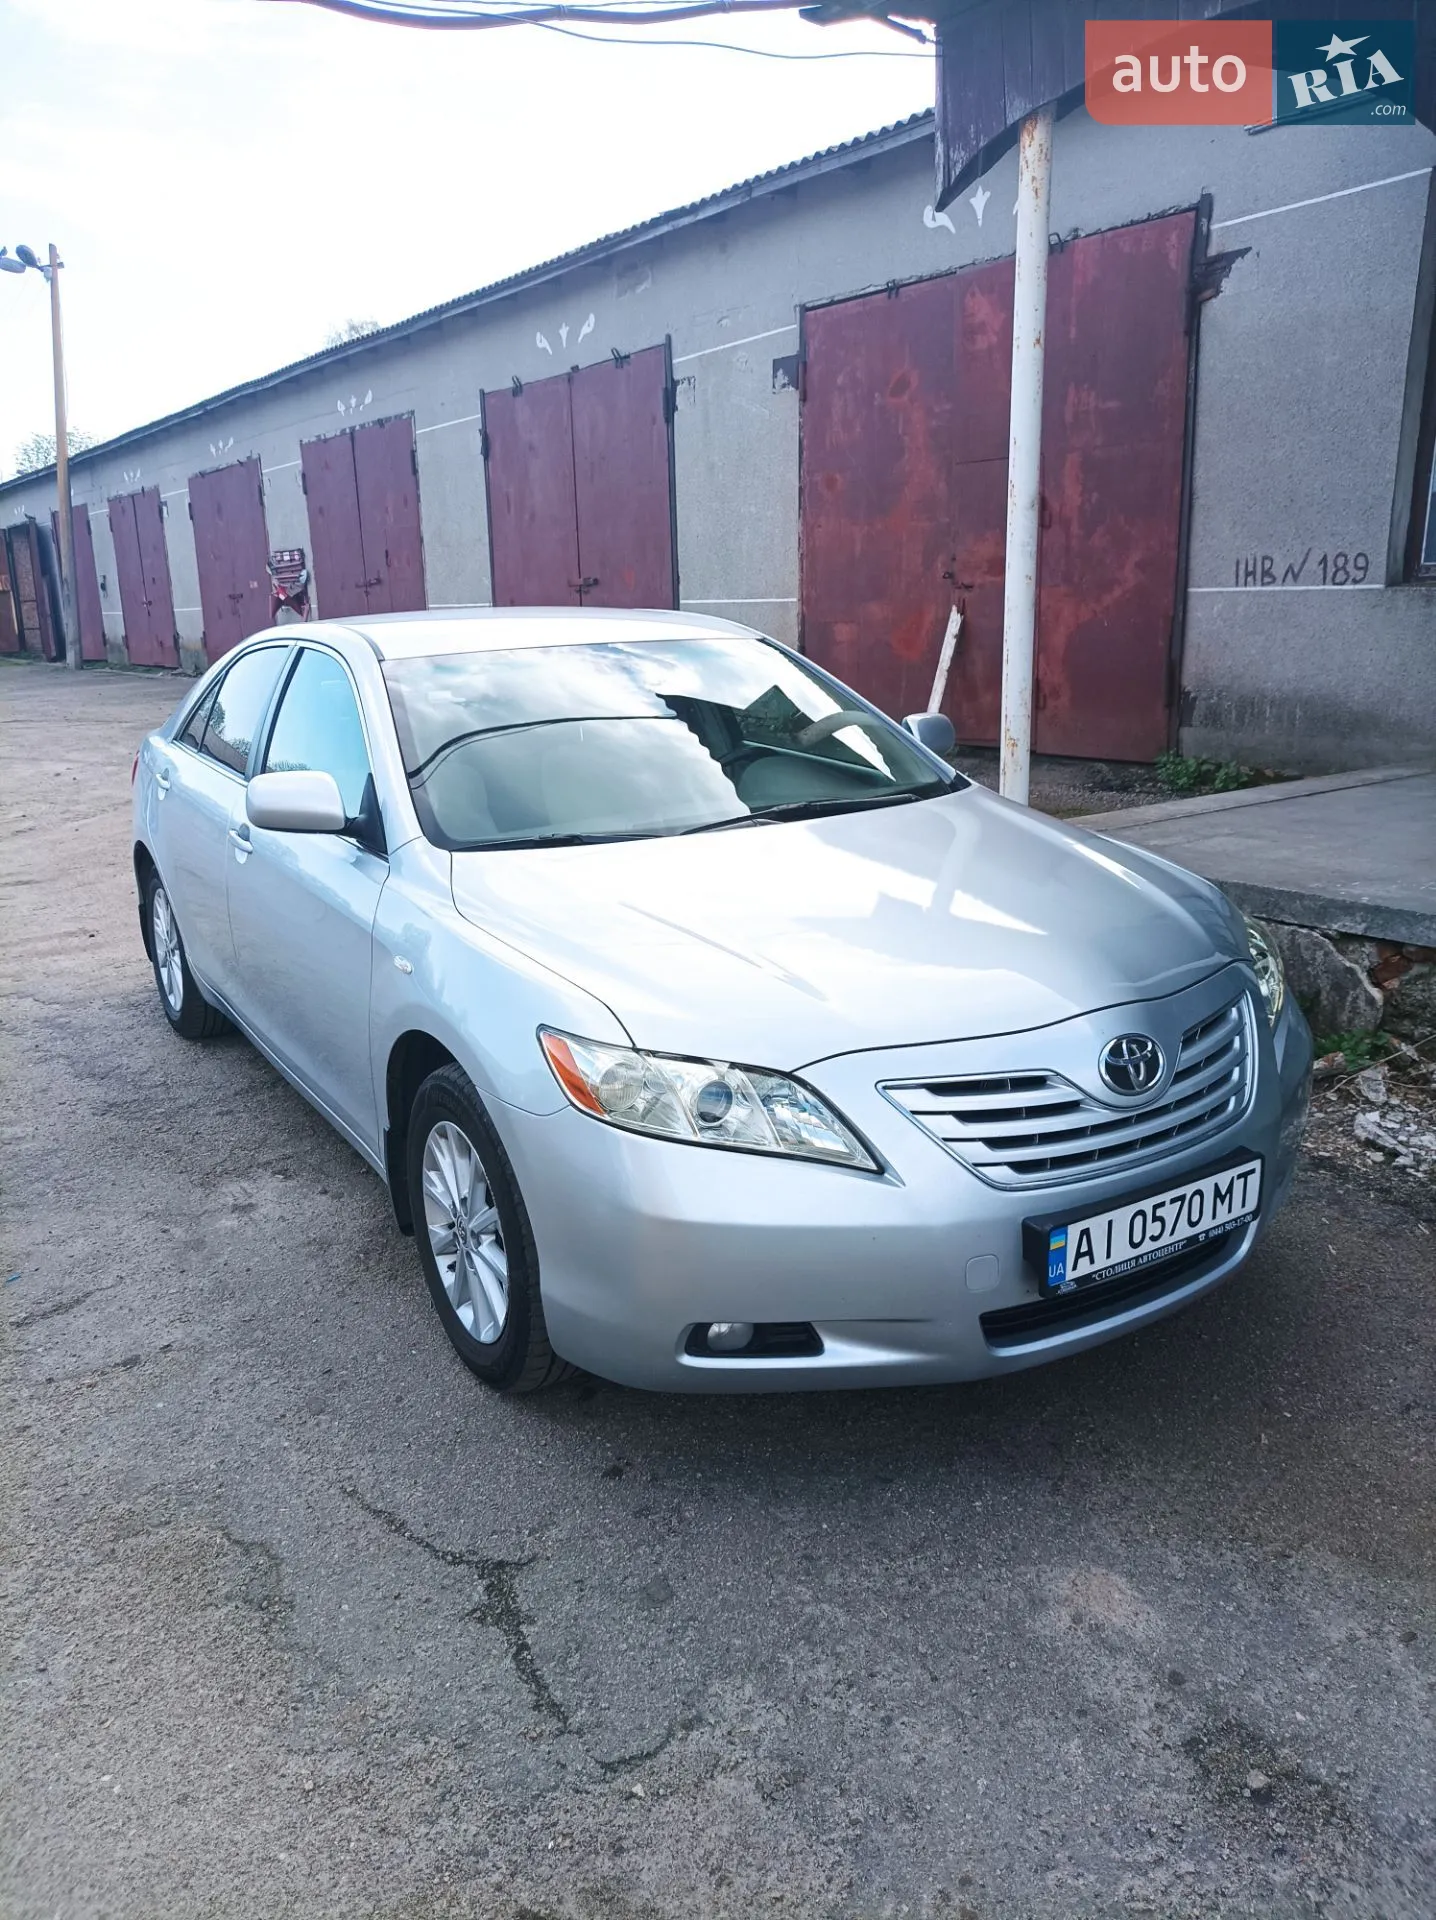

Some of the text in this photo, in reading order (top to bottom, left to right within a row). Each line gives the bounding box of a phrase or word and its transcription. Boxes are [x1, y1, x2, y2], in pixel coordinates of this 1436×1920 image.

[1318, 552, 1370, 586] 189
[1072, 1168, 1256, 1271] AI 0570 MT
[1048, 1263, 1064, 1278] UA
